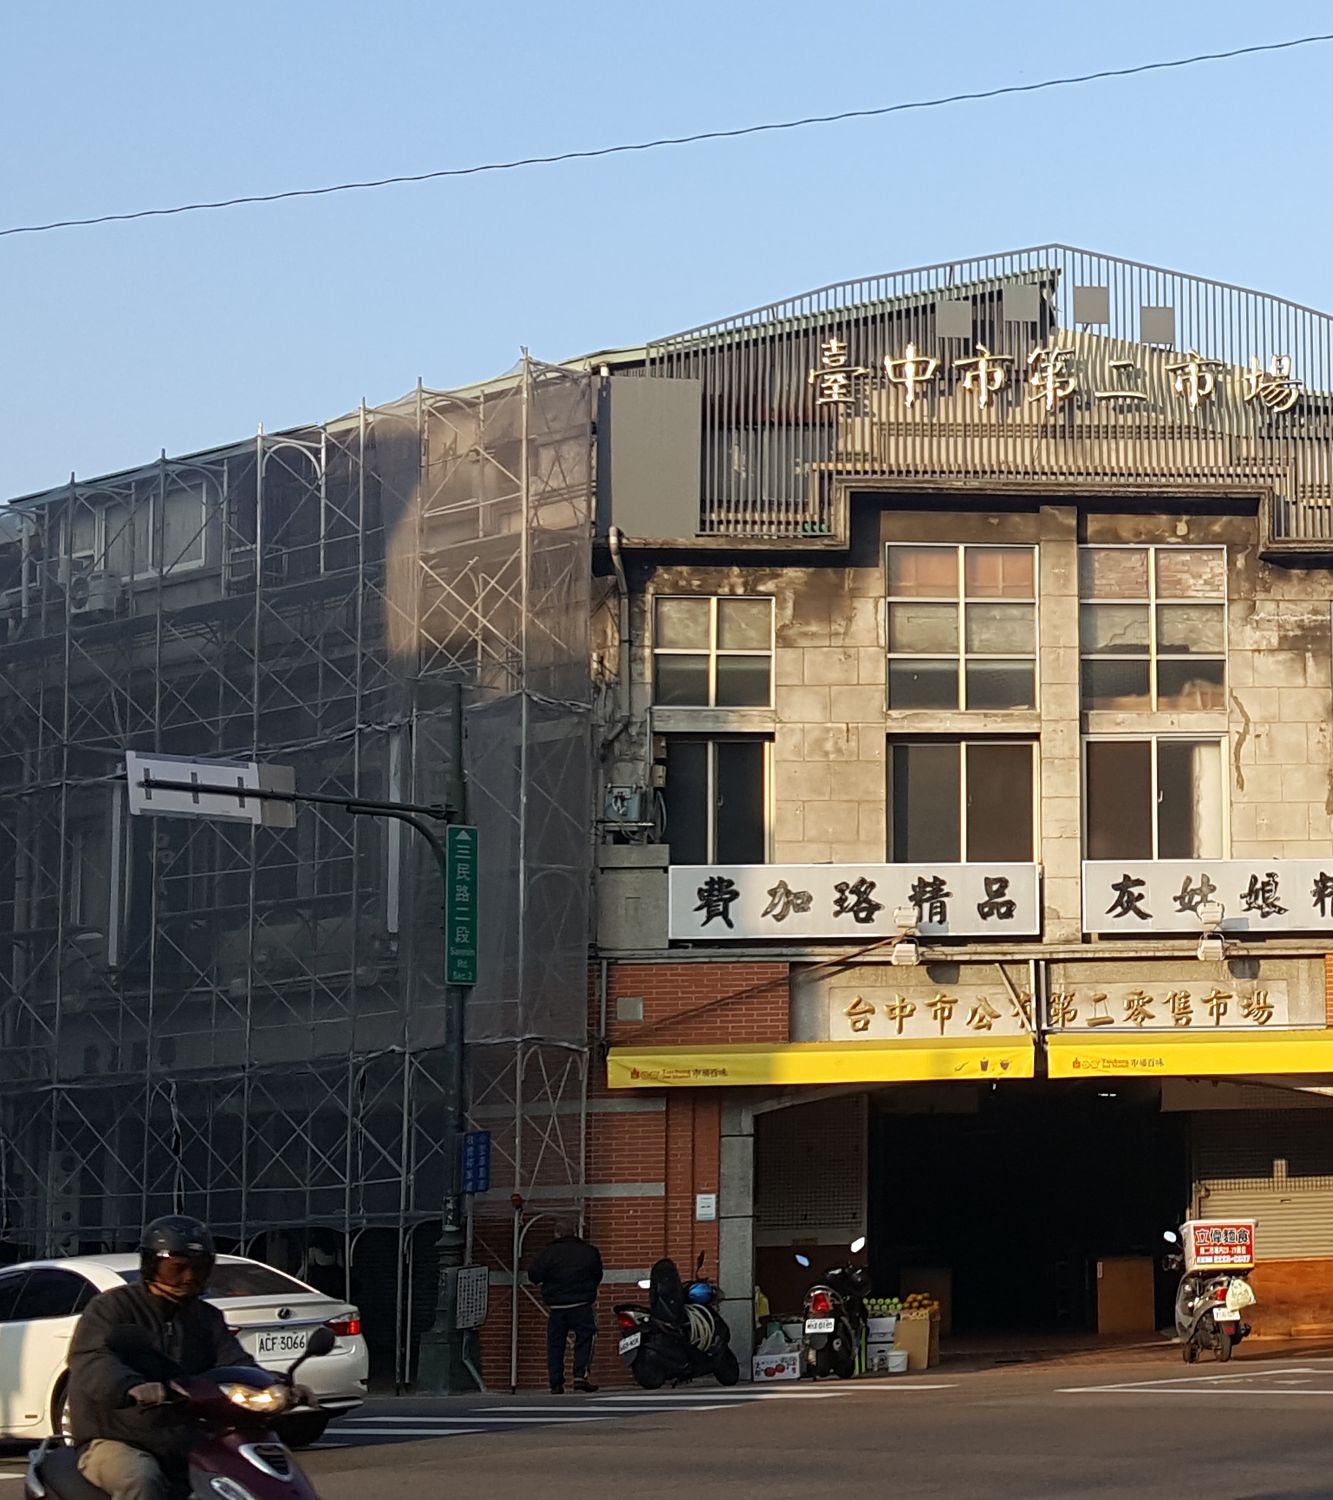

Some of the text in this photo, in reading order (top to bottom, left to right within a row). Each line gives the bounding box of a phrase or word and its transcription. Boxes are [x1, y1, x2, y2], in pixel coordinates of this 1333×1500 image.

[809, 338, 1303, 413] 臺中市第二市場
[455, 844, 471, 943] 三民路二段
